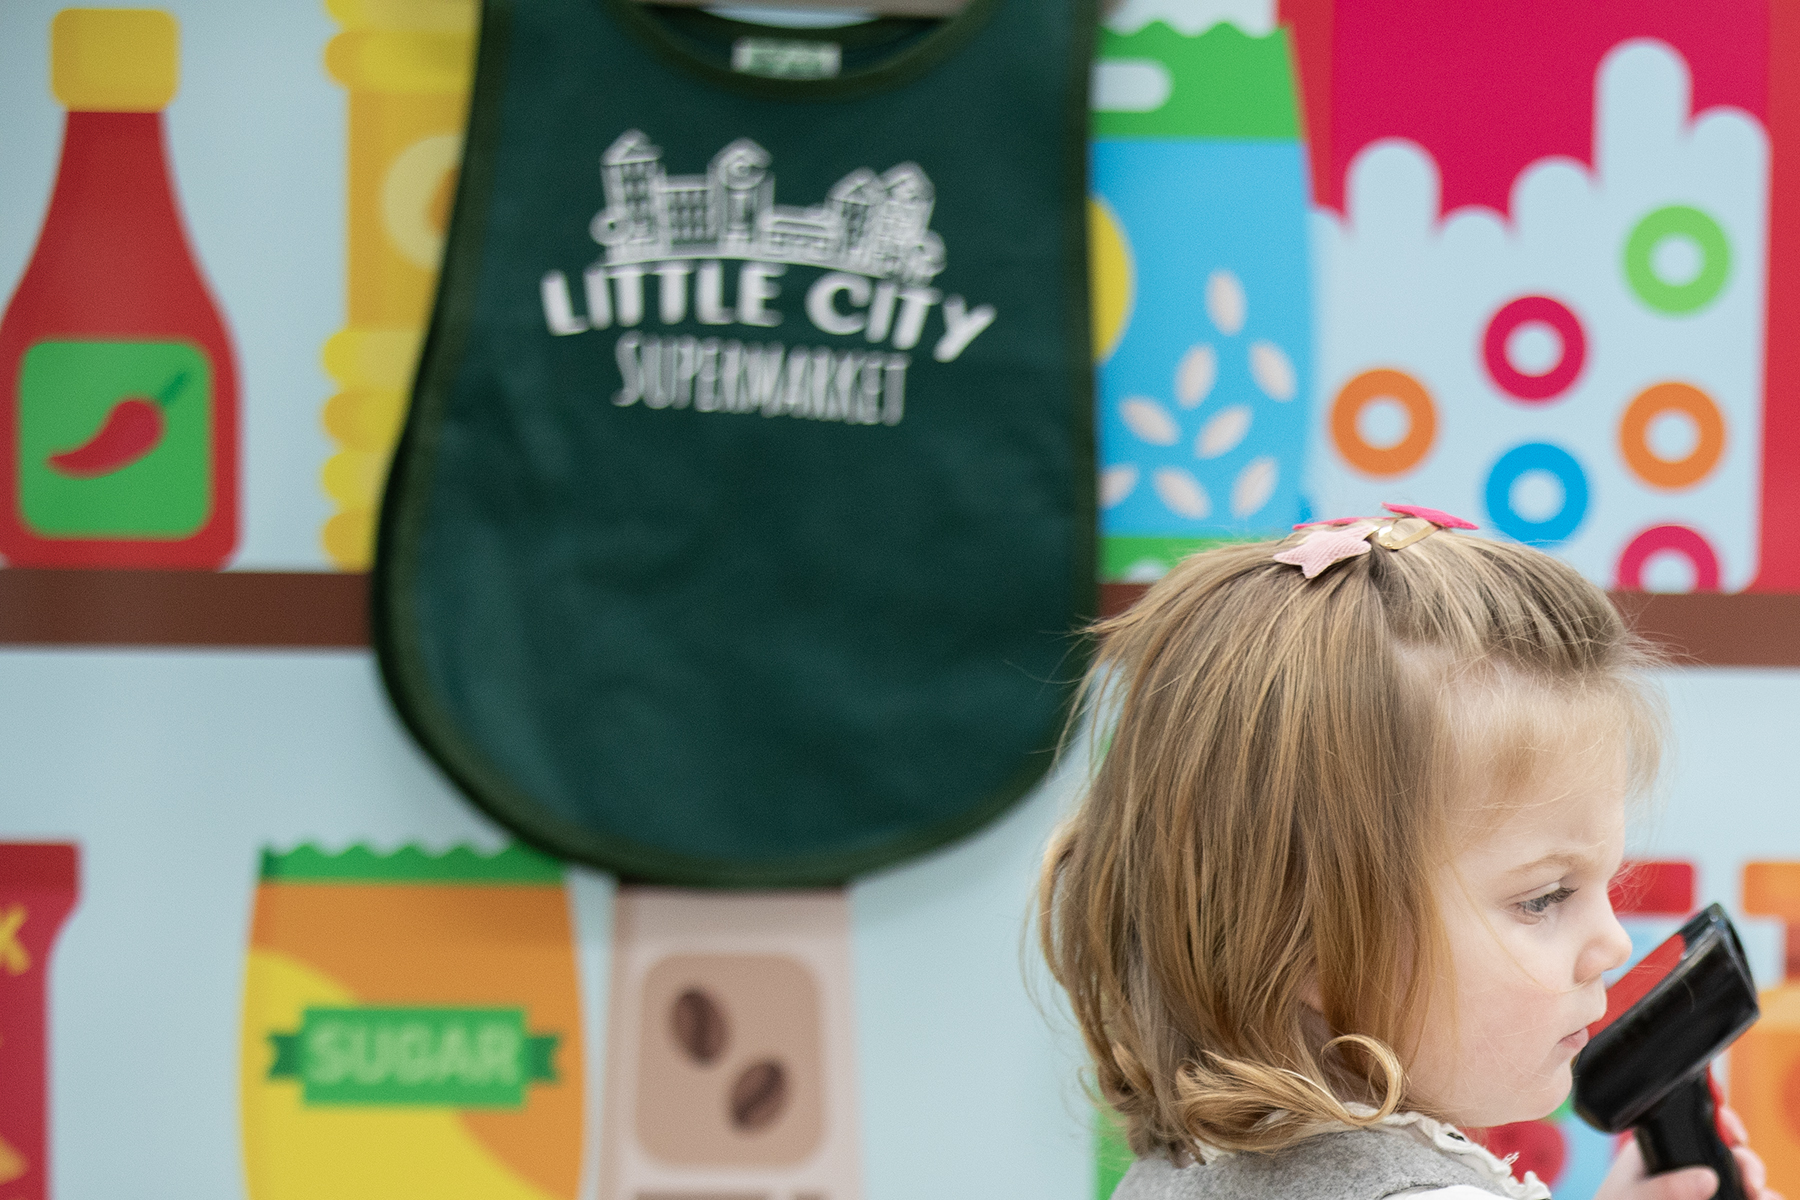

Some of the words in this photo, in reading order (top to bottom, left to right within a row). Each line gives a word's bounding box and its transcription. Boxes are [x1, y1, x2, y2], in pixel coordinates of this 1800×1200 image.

[540, 261, 786, 337] LITTLE
[805, 271, 997, 363] CITY
[611, 330, 912, 427] SUPERMARKET
[307, 1021, 520, 1085] SUGAR
